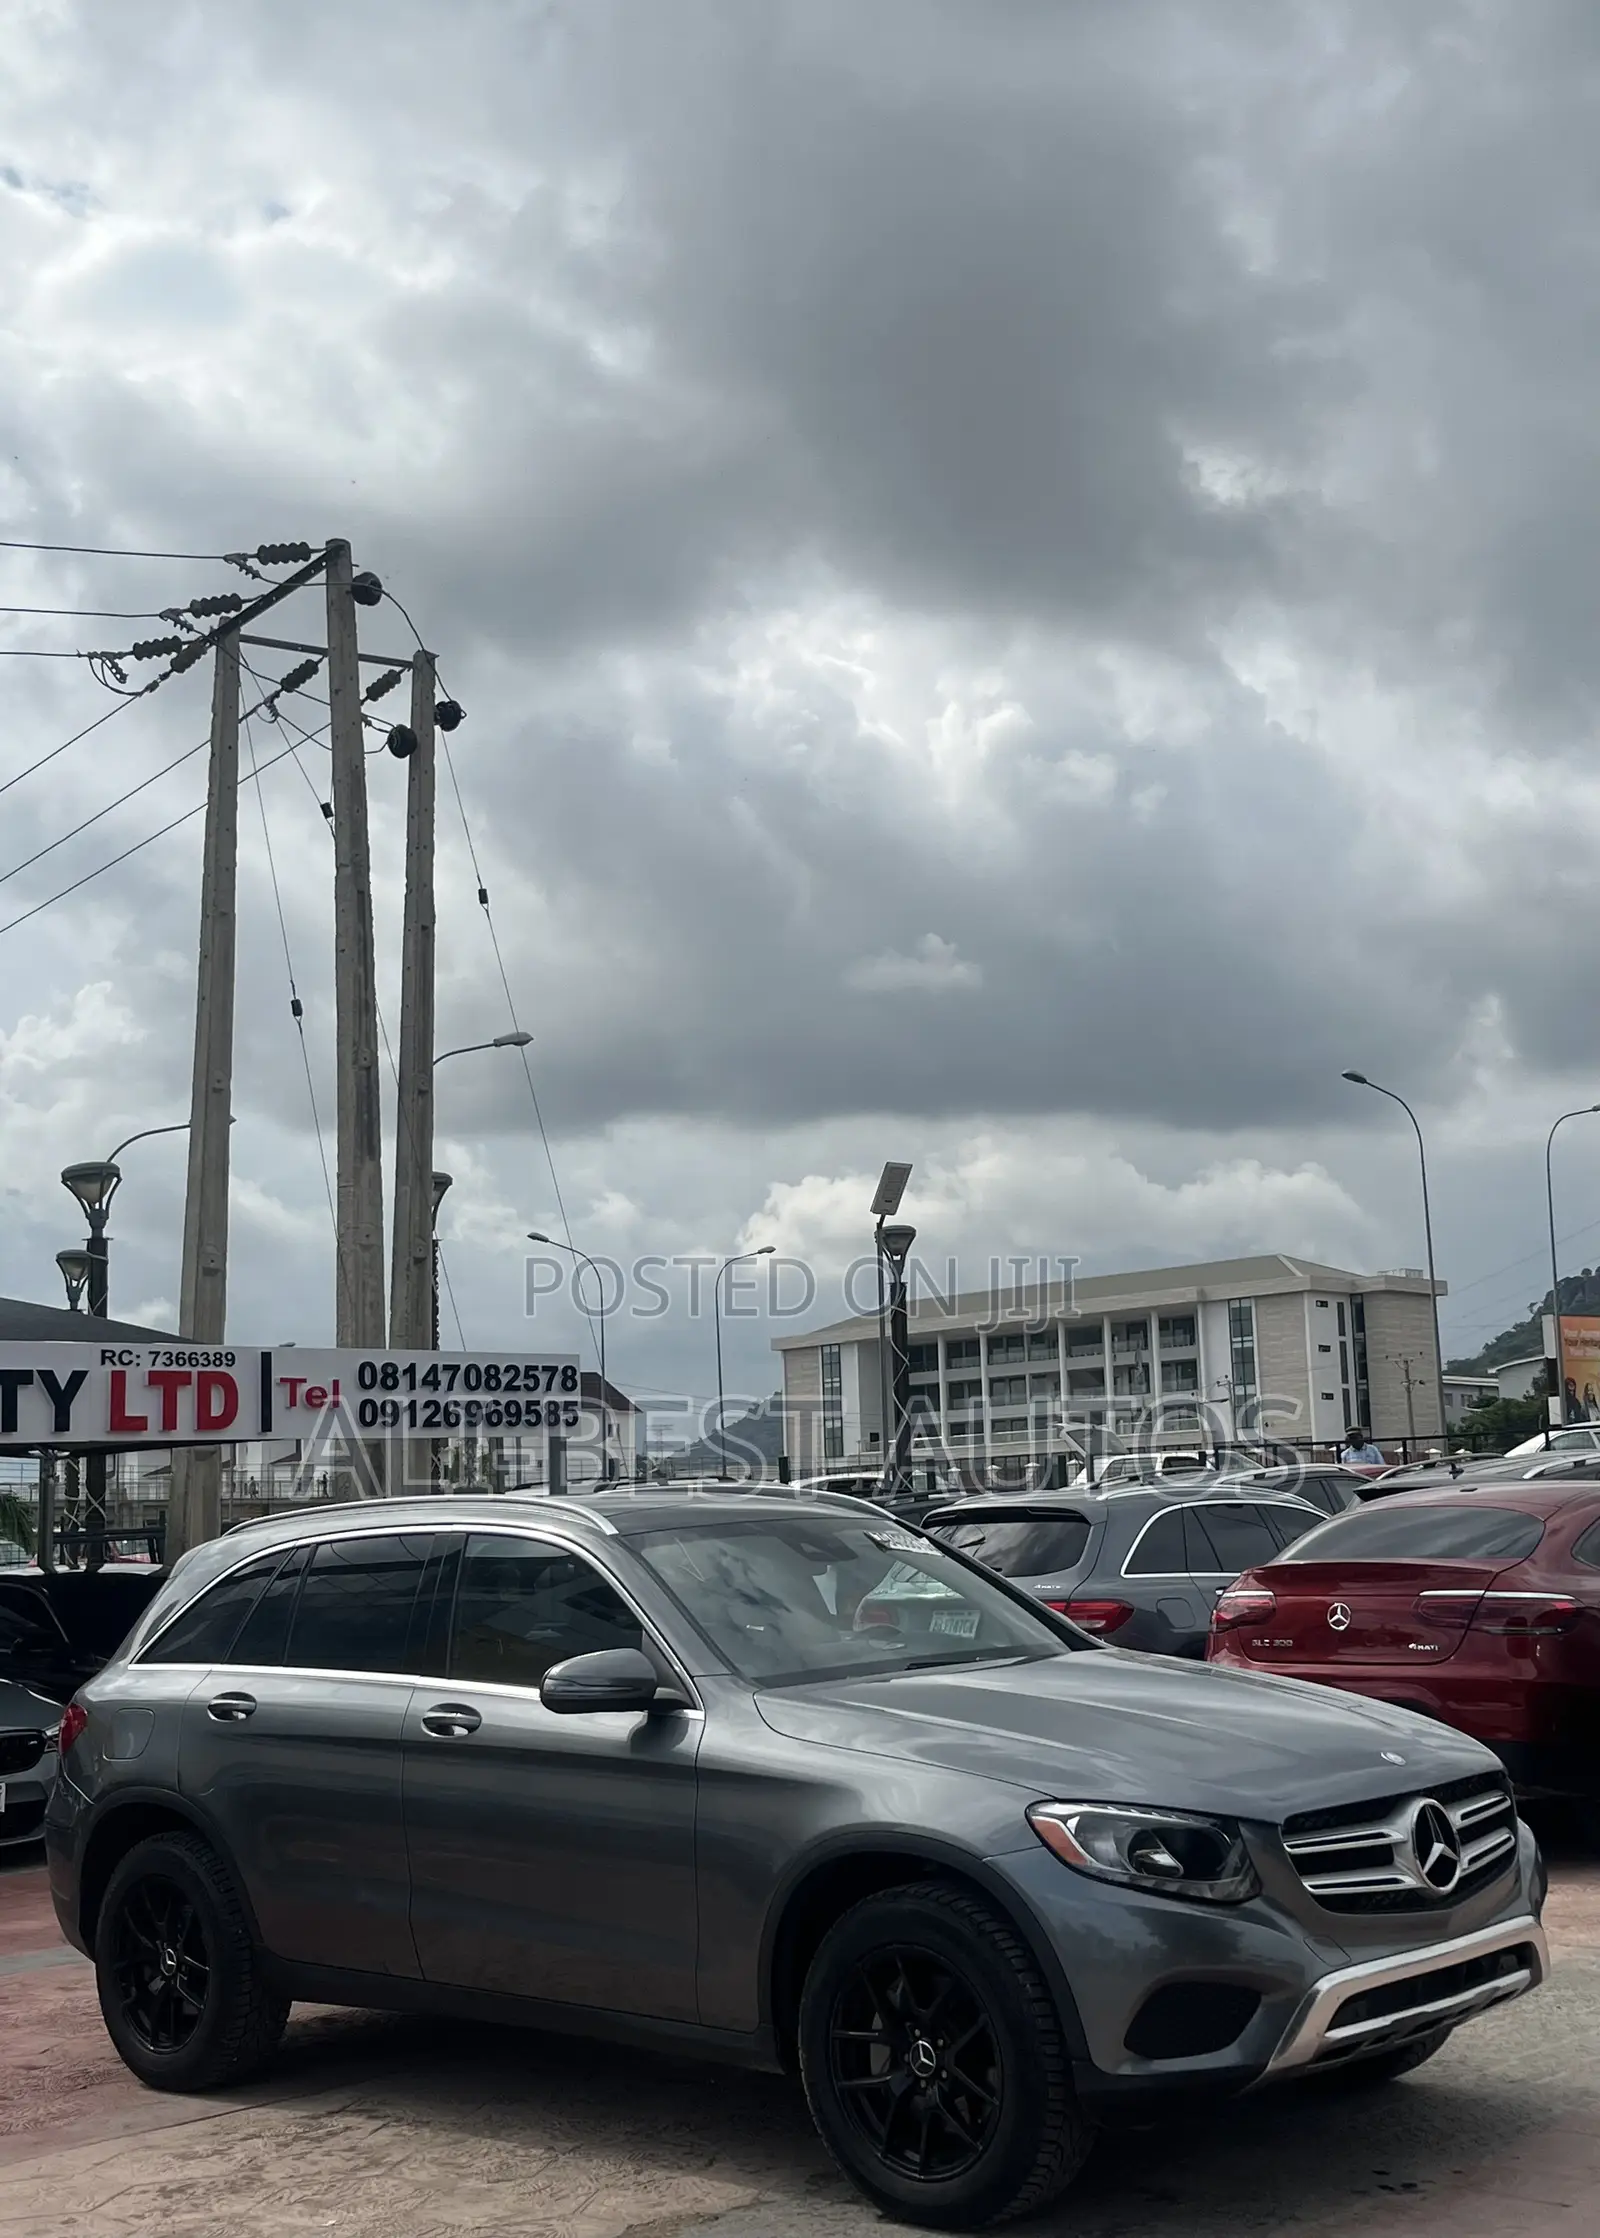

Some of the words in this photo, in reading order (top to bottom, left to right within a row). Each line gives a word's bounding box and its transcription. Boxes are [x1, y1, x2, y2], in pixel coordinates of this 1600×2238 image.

[100, 1349, 141, 1367] RC:
[148, 1350, 236, 1368] 7366389
[279, 1377, 341, 1409] Tel
[357, 1361, 579, 1393] 08147082578
[109, 1369, 240, 1432] LTD
[357, 1398, 580, 1429] 09126969585
